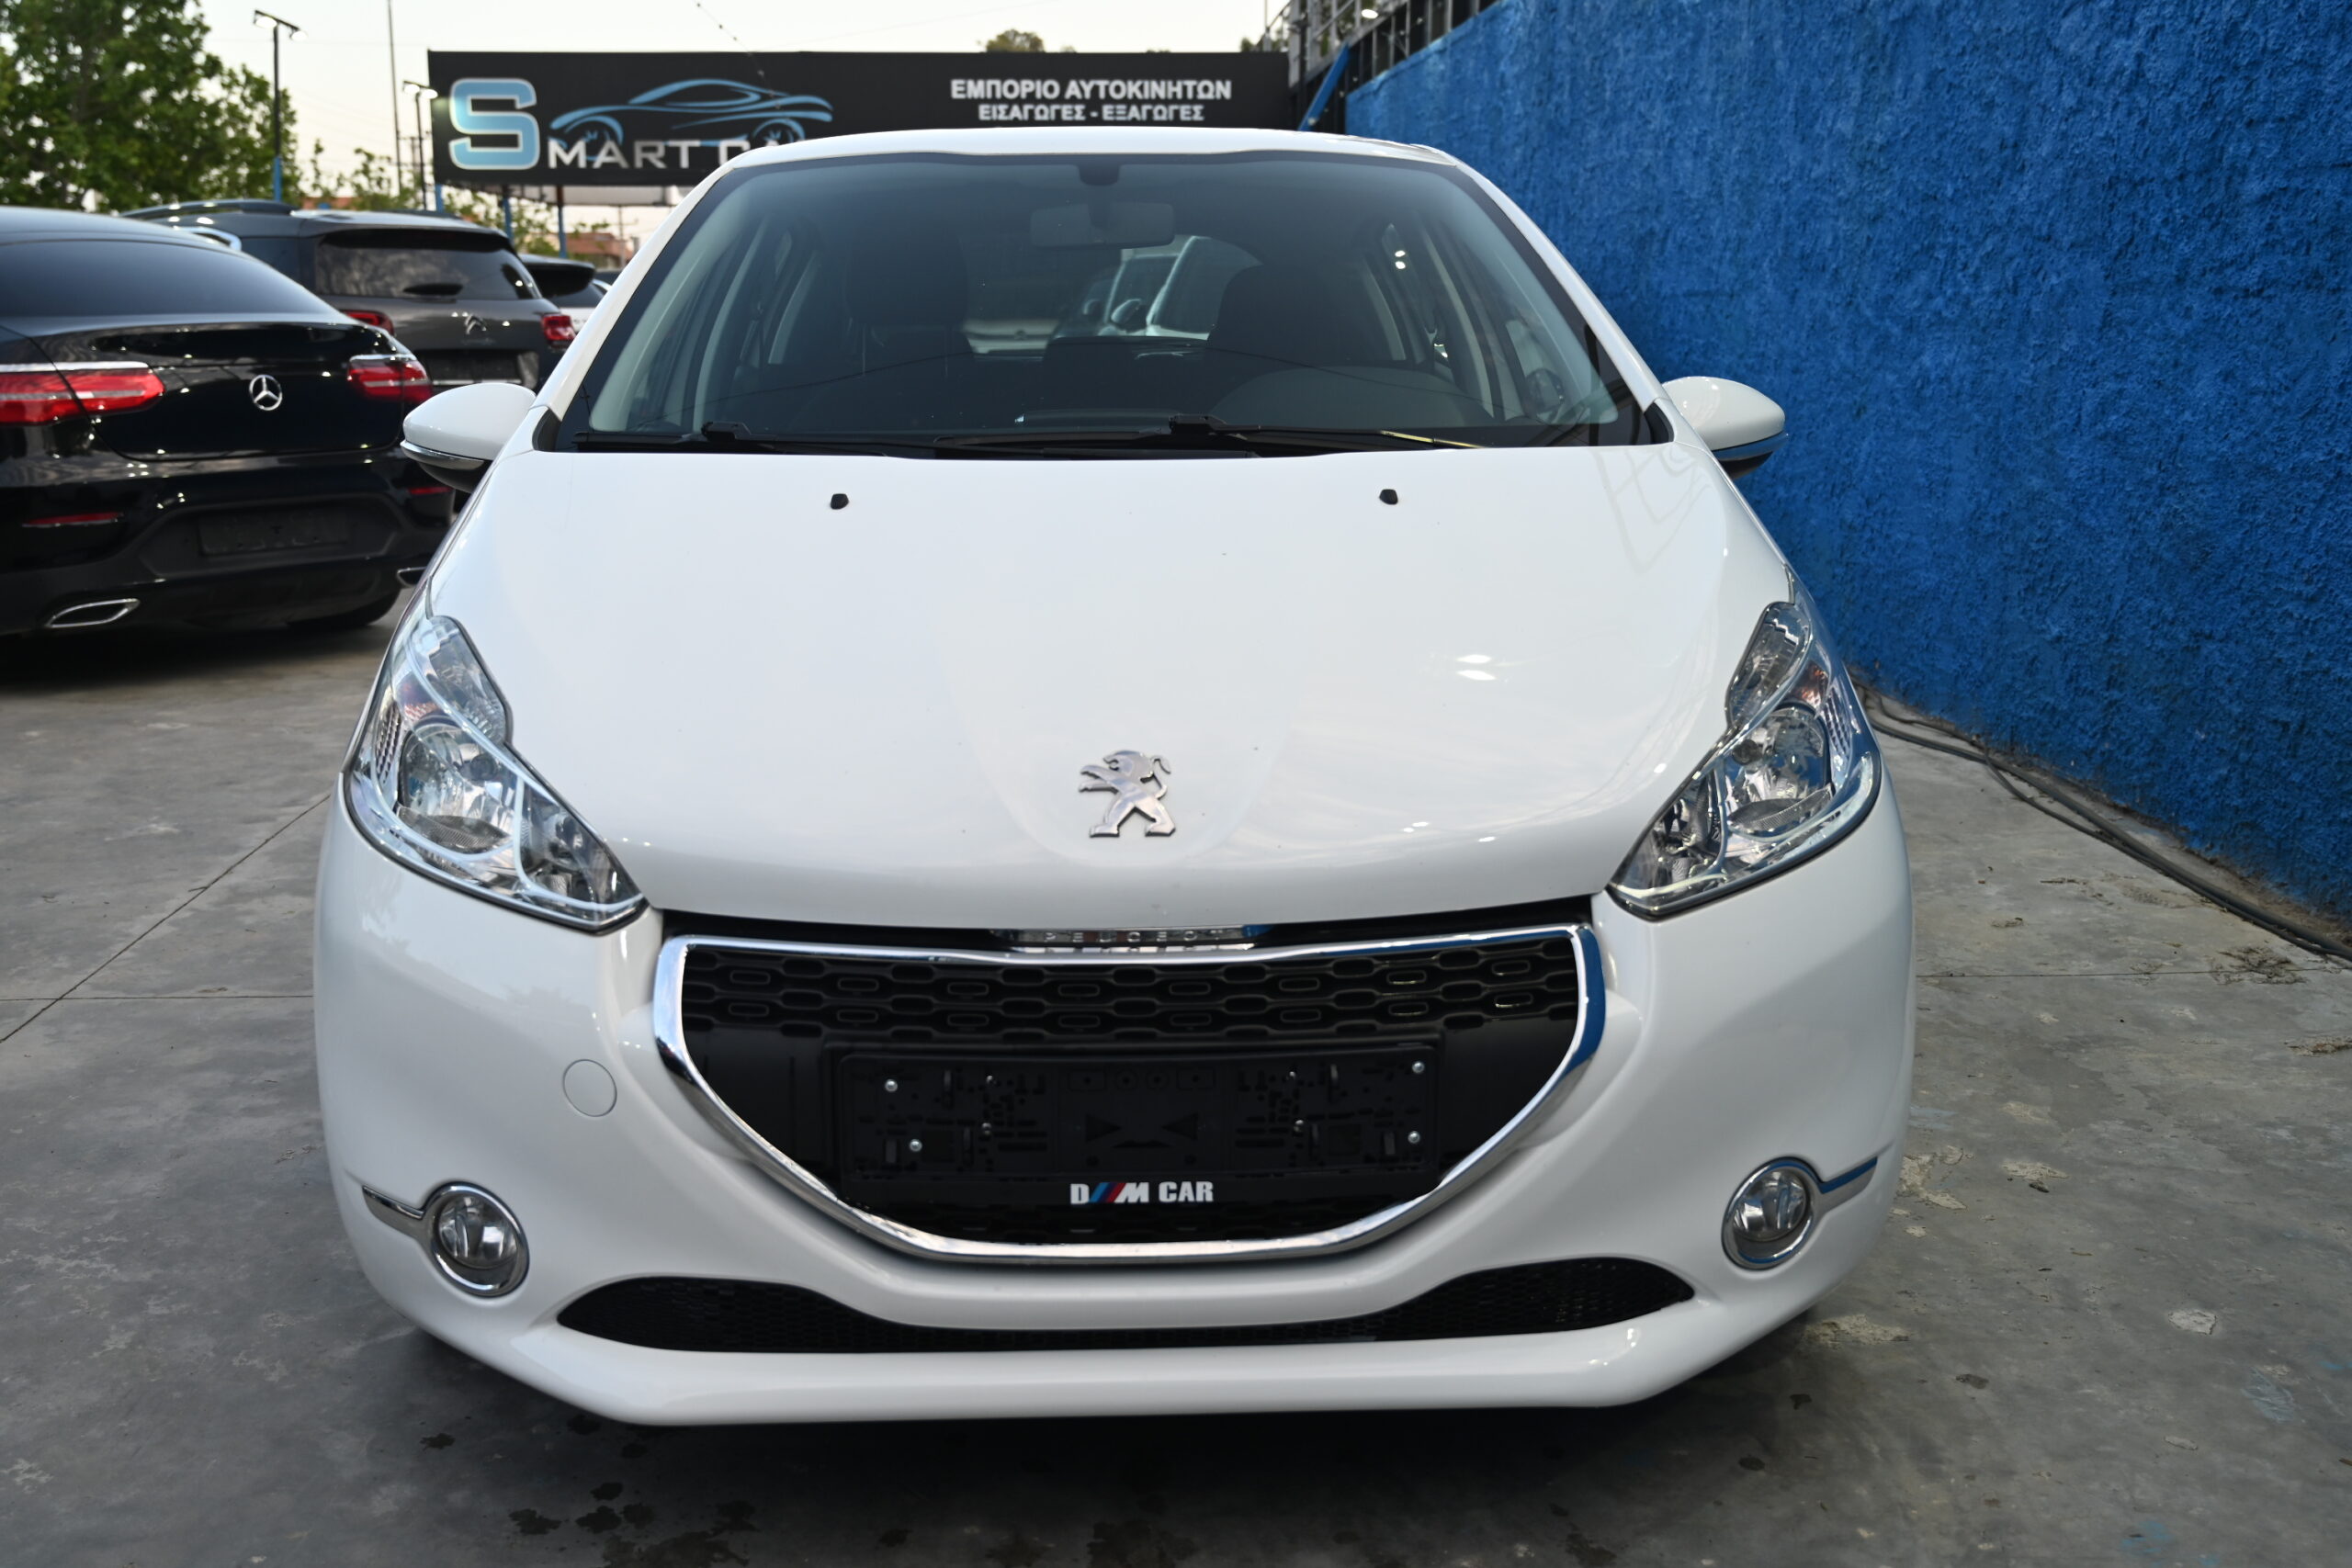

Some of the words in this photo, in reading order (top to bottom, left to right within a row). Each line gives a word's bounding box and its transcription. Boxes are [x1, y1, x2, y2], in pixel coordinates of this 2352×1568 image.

[951, 79, 1060, 100] ΕΜΠΟΡΙΟ
[1064, 79, 1232, 100] ΑΥΤΟΚΙΝΗΤΩΝ
[448, 77, 701, 170] SMART
[978, 104, 1086, 121] ΕΙΣΑΓΩΓΕΣ
[1102, 104, 1204, 121] ΕΞΑΓΩΓΕΣ
[1159, 1180, 1215, 1203] CAR
